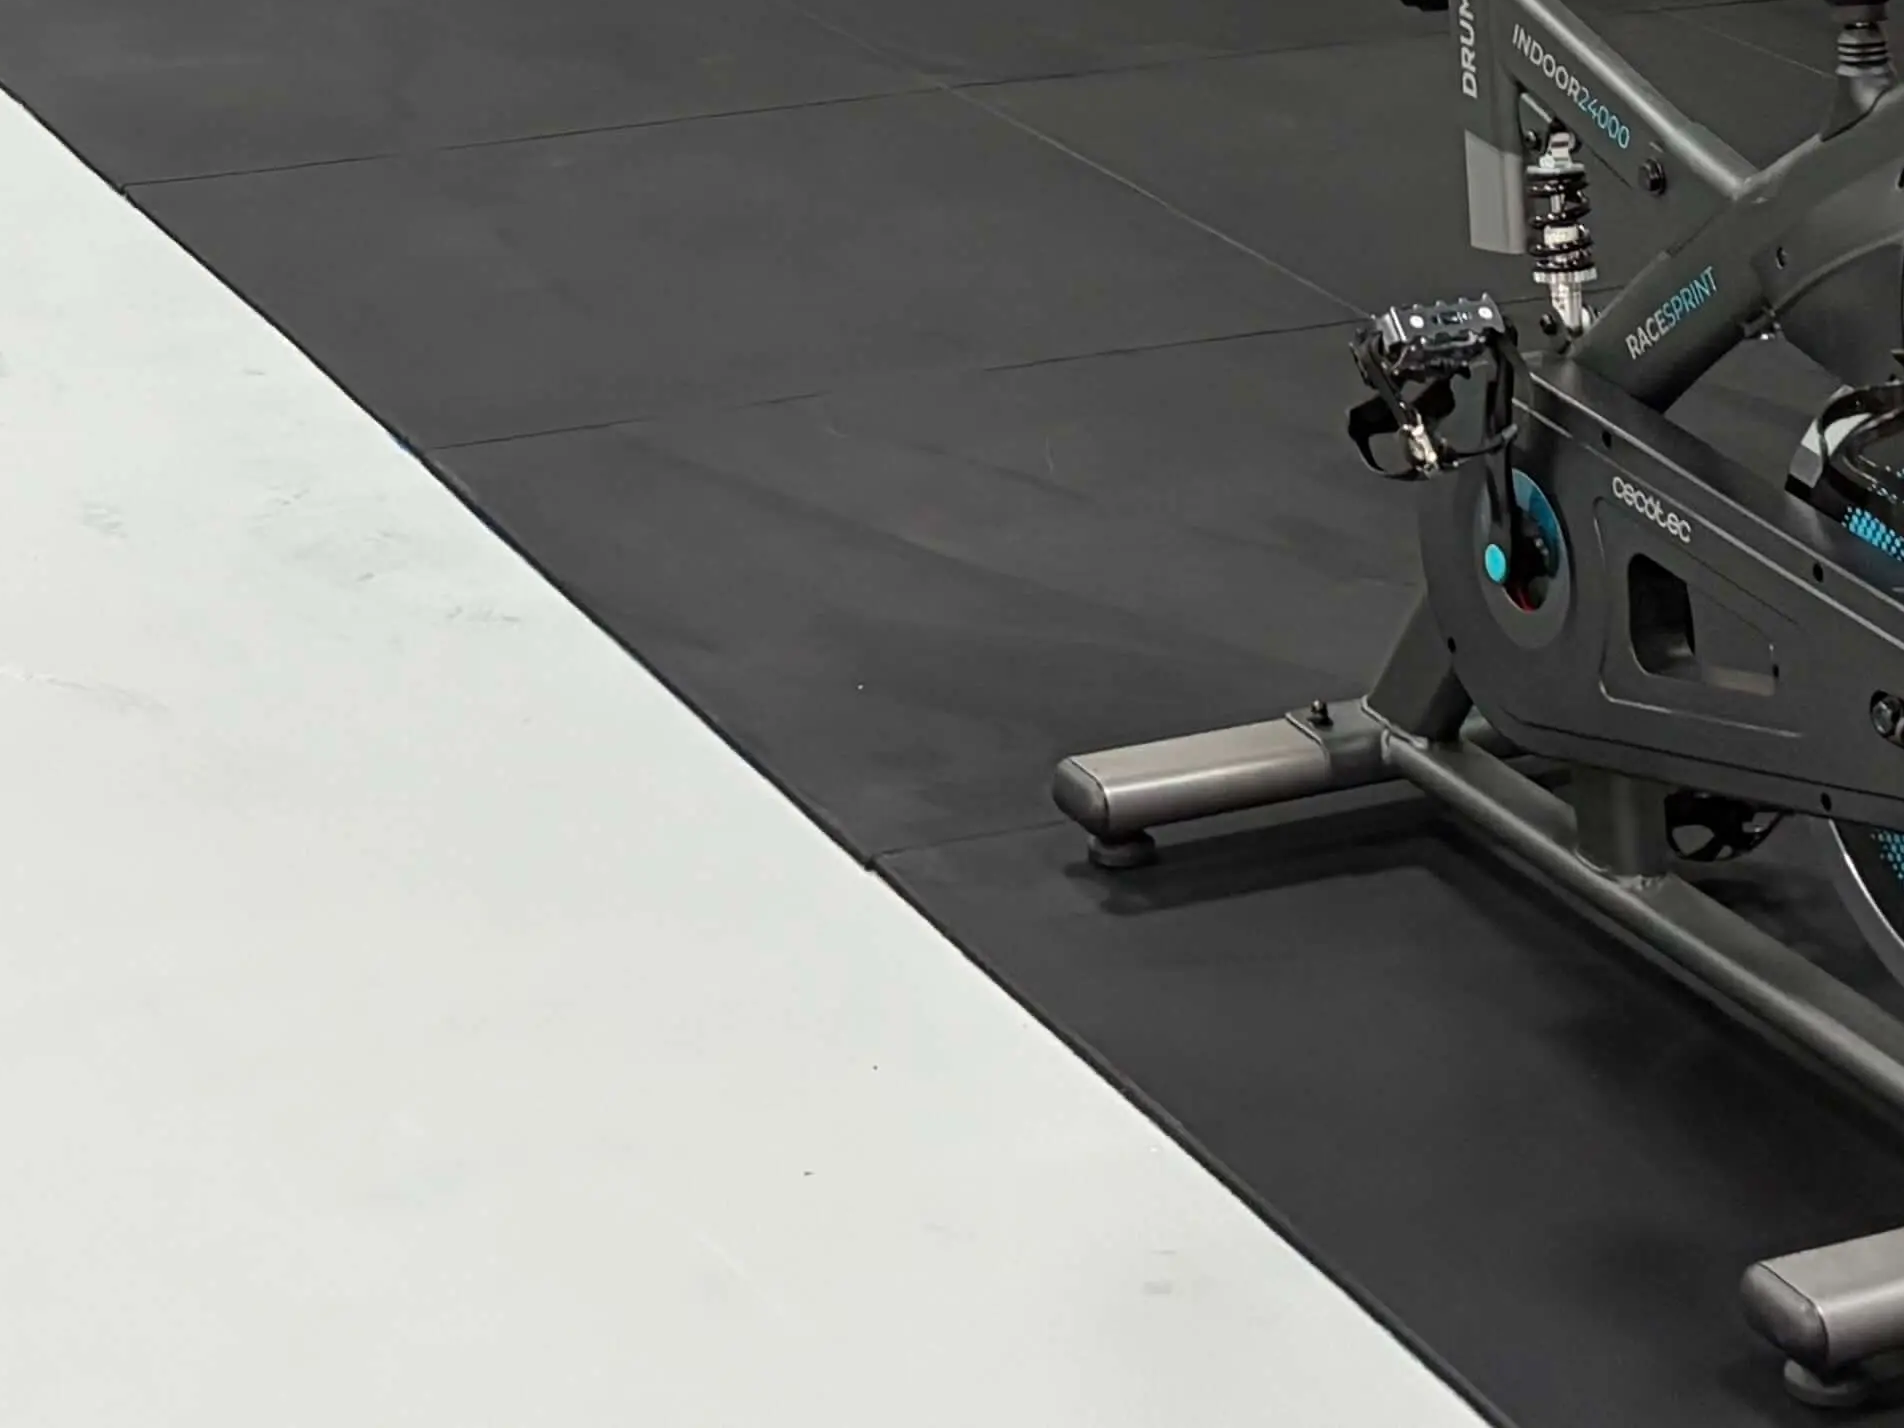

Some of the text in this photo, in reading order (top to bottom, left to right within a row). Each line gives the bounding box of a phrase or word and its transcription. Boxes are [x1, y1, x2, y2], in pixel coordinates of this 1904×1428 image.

[1512, 22, 1631, 150] INDOOR24000
[1625, 264, 1719, 361] RACESPRINT
[1612, 476, 1692, 543] cecotec
